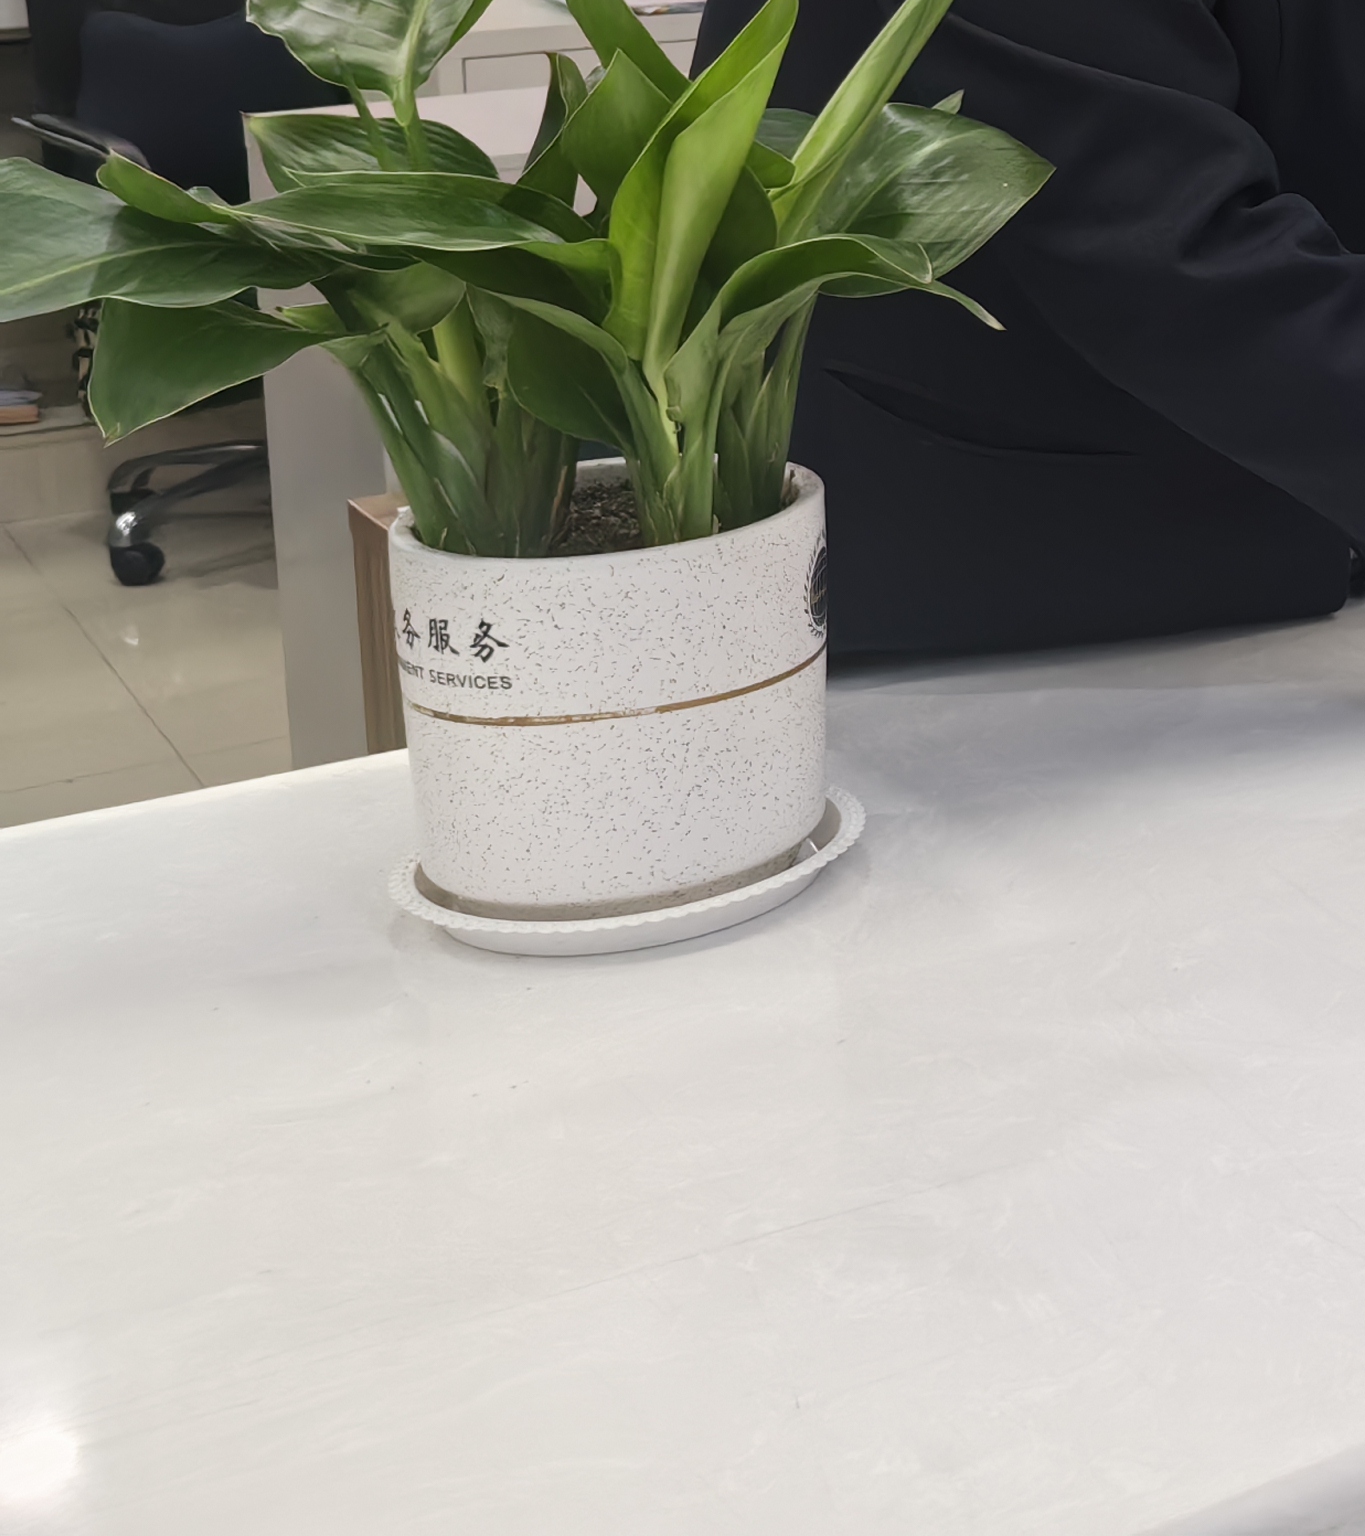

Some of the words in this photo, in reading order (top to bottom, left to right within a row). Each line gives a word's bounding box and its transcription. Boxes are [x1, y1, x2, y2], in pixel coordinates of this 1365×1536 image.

[395, 608, 510, 663] 务服务
[429, 669, 513, 690] SERVICES
